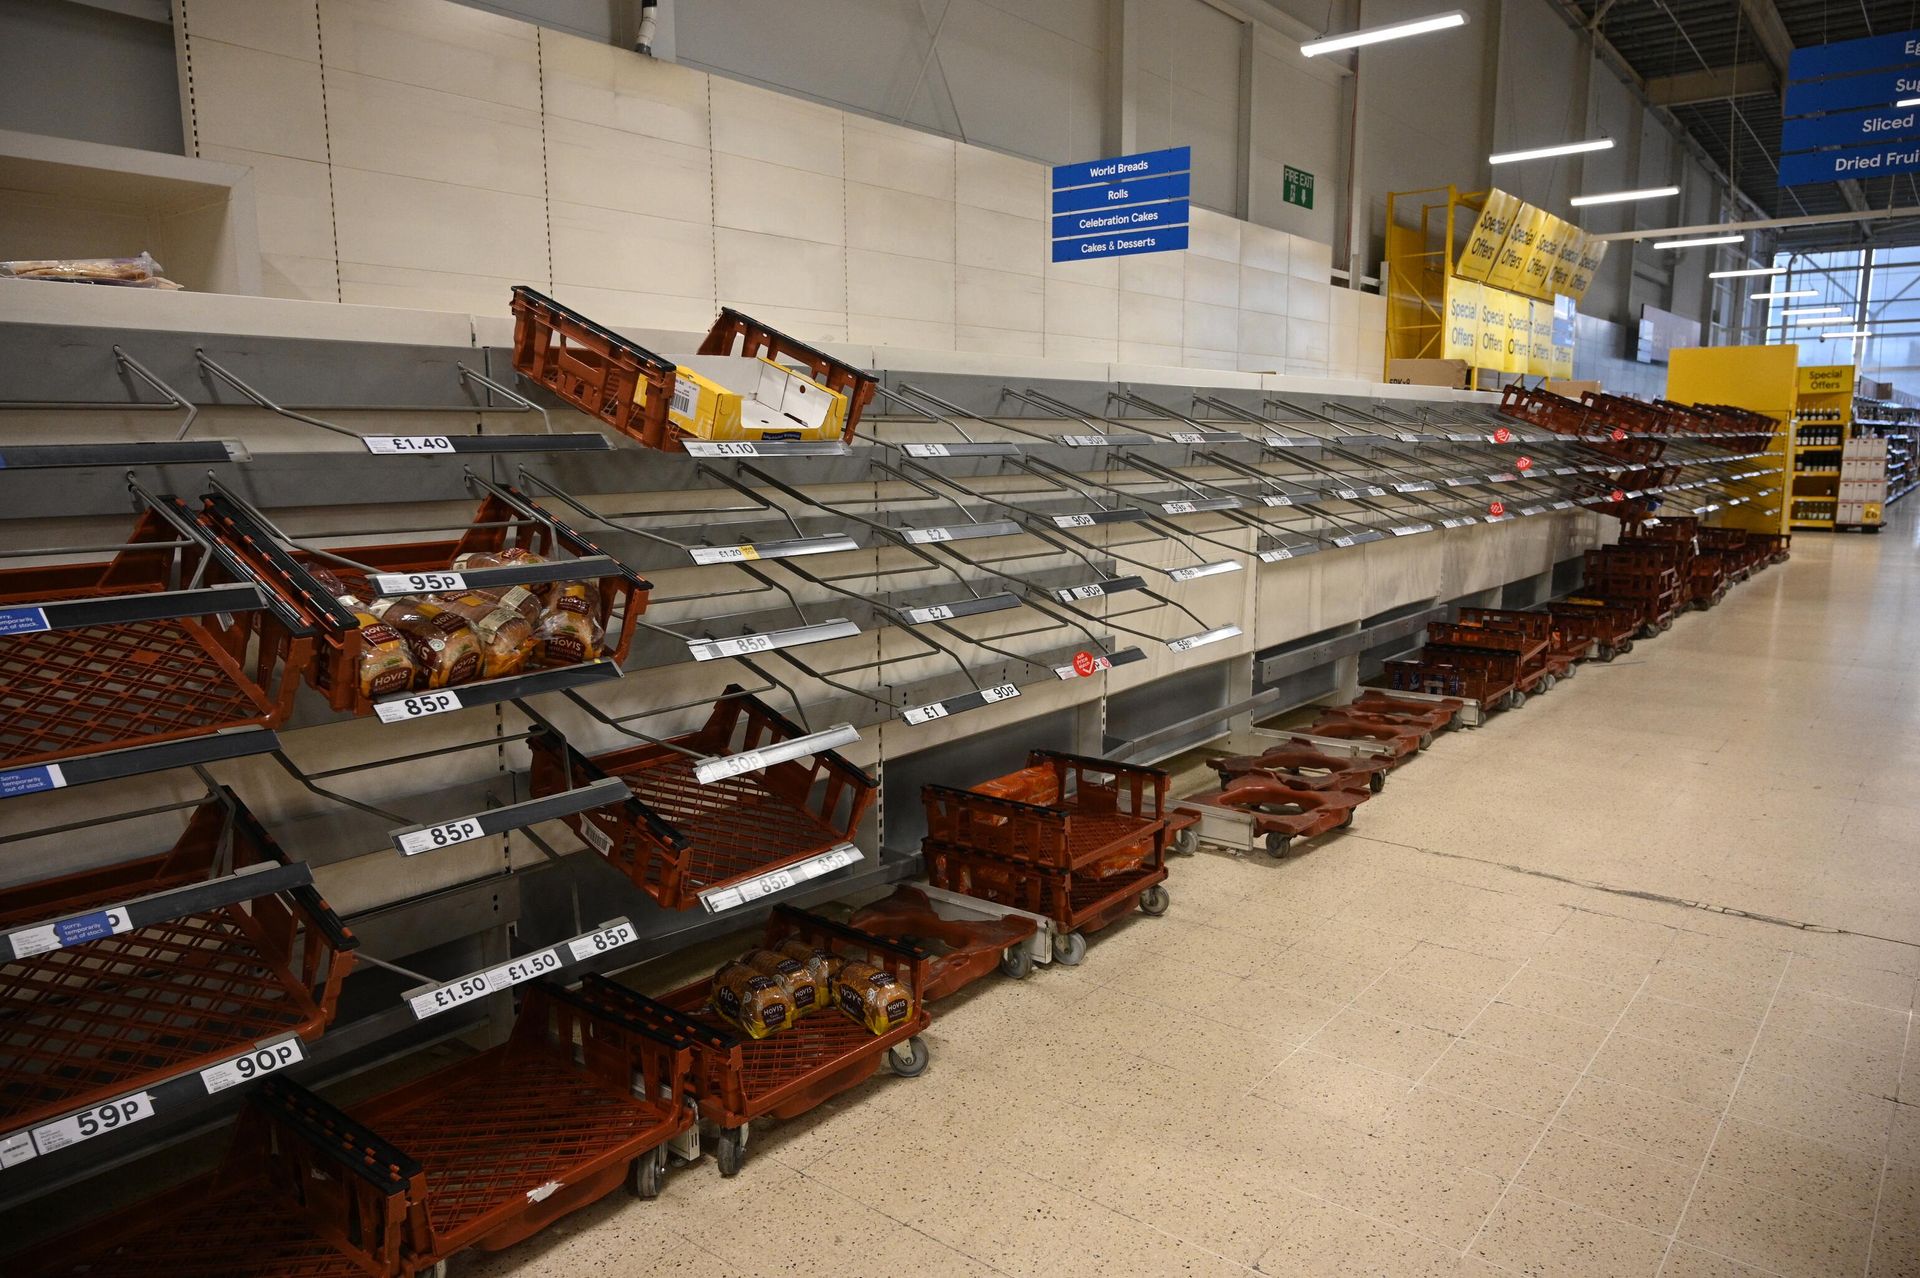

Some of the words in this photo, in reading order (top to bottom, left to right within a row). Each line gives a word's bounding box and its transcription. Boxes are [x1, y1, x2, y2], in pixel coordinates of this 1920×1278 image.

[1862, 114, 1914, 133] Sliced
[1089, 166, 1116, 178] World
[1117, 159, 1149, 174] Breads
[1835, 154, 1881, 172] Dried
[1886, 149, 1920, 166] Frui
[1284, 169, 1299, 185] FIRE
[1300, 174, 1313, 189] EXIT
[1107, 189, 1129, 201] Rolls
[1079, 212, 1130, 229] Celebration
[1130, 210, 1159, 223] Cakes
[1481, 210, 1510, 235] Special
[1511, 223, 1538, 246] Special
[1081, 242, 1107, 254] Cakes
[1108, 240, 1115, 251] &
[1117, 236, 1156, 250] Desserts
[1472, 237, 1495, 260] Offers
[1501, 248, 1523, 270] Offers
[1451, 298, 1478, 321] Special
[1451, 327, 1475, 348] Offers
[1482, 332, 1504, 353] Offers
[1508, 338, 1530, 356] Offers
[1809, 370, 1843, 380] Special
[1811, 380, 1841, 390] Offers
[392, 437, 449, 450] £1.40
[717, 442, 754, 455] £1.10
[924, 444, 941, 455] £1
[1071, 515, 1091, 526] 90p
[926, 529, 945, 540] £2
[718, 549, 742, 558] £1.20
[409, 574, 456, 591] 95p
[1179, 569, 1195, 579] 59p
[1081, 586, 1101, 597] 90p
[928, 607, 946, 619] £2
[551, 638, 581, 651] HOVIS
[736, 637, 767, 652] 85p
[1176, 640, 1193, 650] 59p
[451, 655, 477, 674] HOVIS
[374, 670, 408, 687] HOVIS
[993, 685, 1015, 699] 90p
[404, 694, 450, 716] 85p
[923, 706, 940, 719] £1
[727, 752, 761, 773] 50p
[2, 777, 41, 787] temporarily
[431, 823, 474, 846] 85p
[759, 875, 790, 894] 85p
[65, 923, 101, 937] temporarily
[592, 927, 629, 951] 85p
[508, 953, 557, 981] £1.50
[435, 977, 486, 1007] £1.50
[794, 986, 813, 998] HOVIS
[763, 1004, 784, 1016] HOVIS
[887, 1001, 906, 1012] HOVIS
[236, 1046, 292, 1079] 90p
[76, 1100, 139, 1136] 59p
